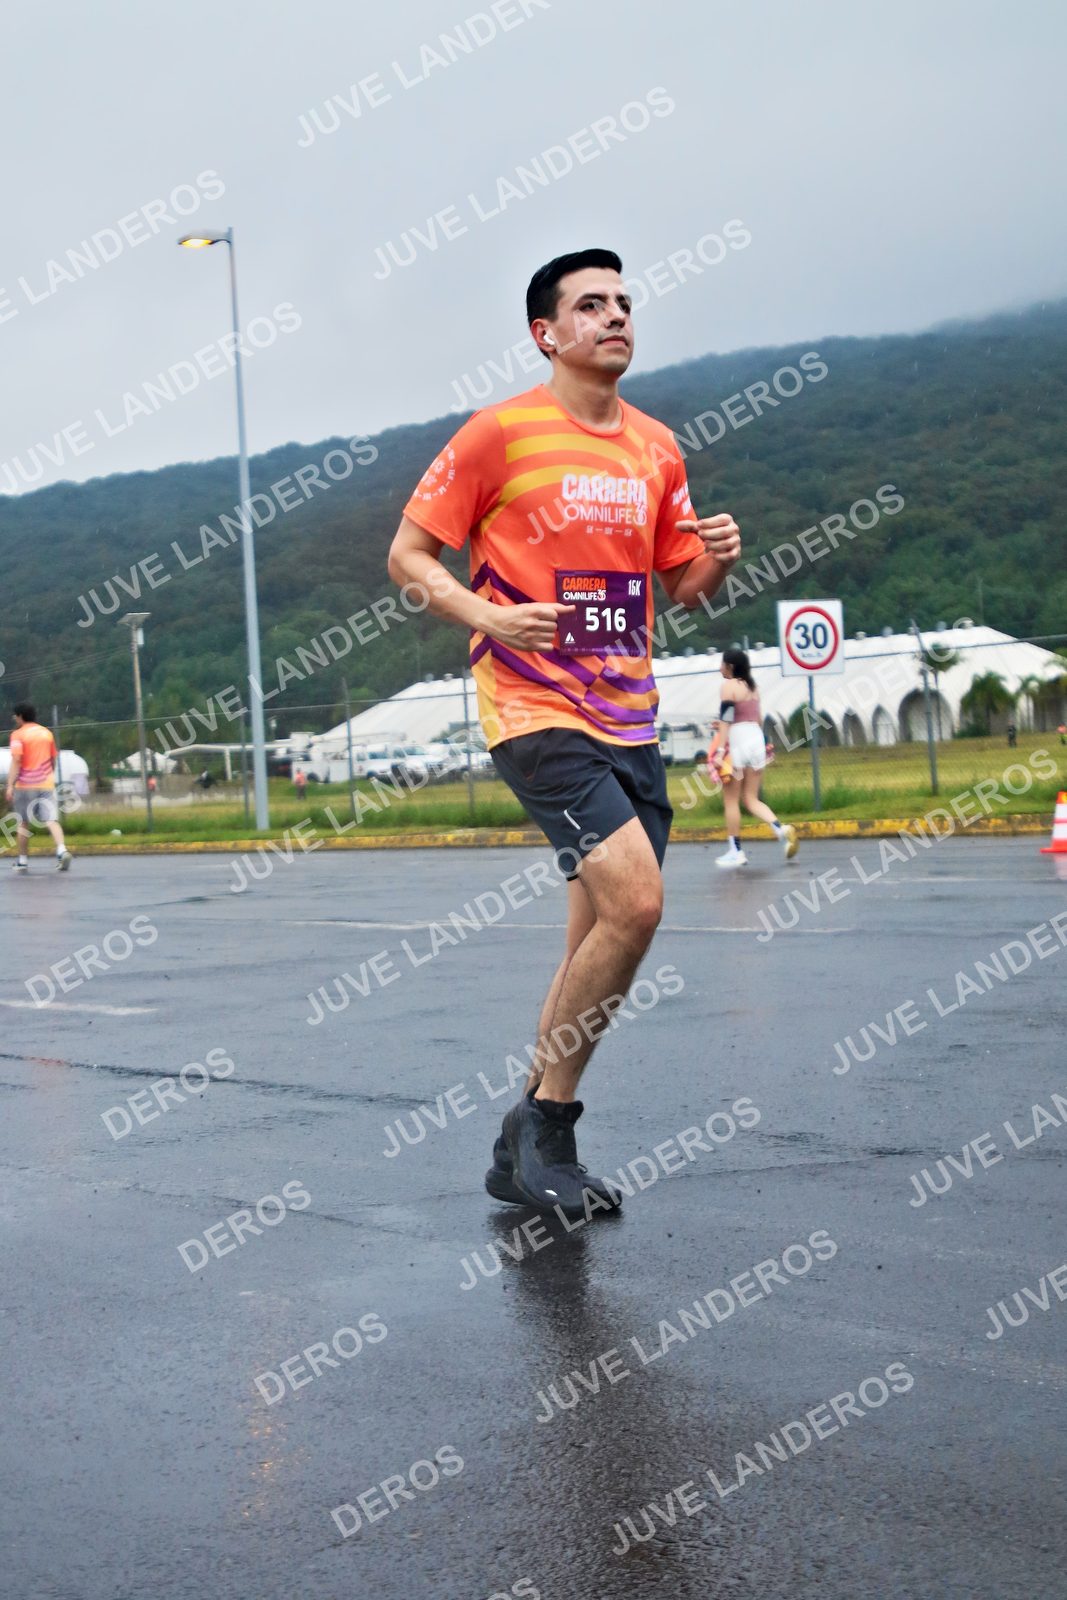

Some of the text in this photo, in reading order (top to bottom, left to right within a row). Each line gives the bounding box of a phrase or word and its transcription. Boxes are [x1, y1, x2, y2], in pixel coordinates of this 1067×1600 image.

[562, 473, 648, 505] CARRERA
[562, 577, 607, 590] CARRERA
[628, 579, 642, 596] 15K
[585, 607, 627, 632] 516
[794, 623, 828, 649] 30
